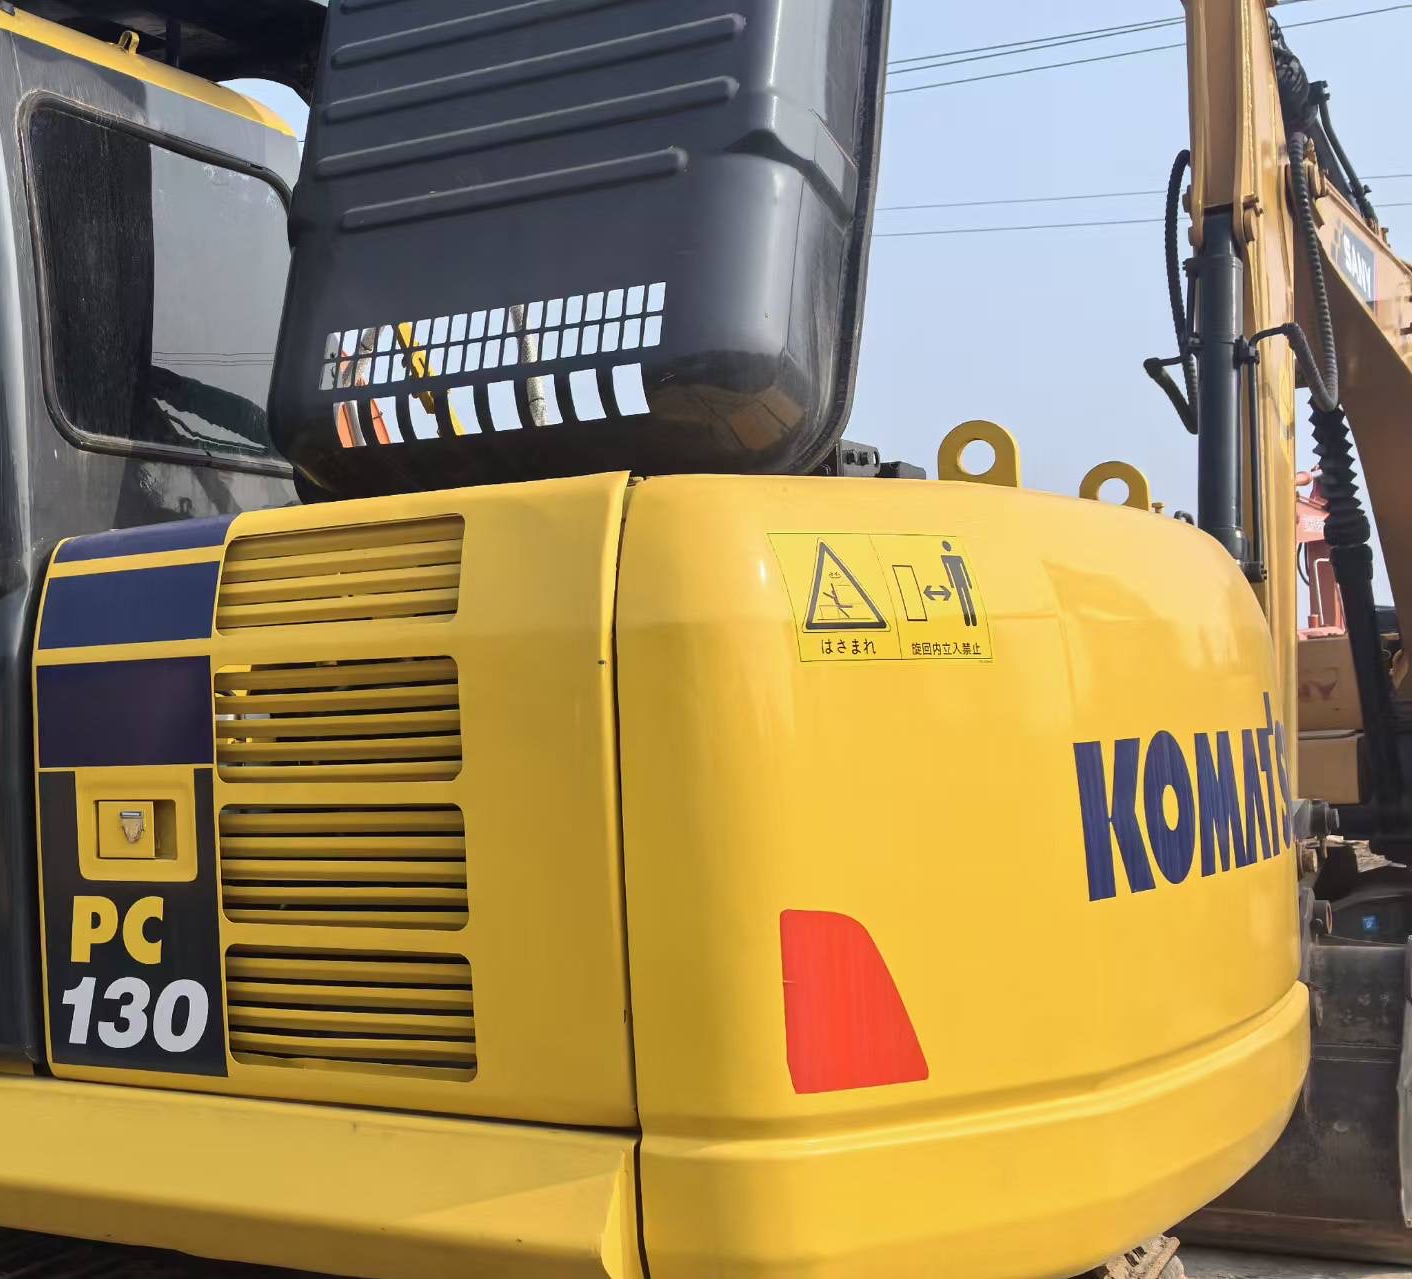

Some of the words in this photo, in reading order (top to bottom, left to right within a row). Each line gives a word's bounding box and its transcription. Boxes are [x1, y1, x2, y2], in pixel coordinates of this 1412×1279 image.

[821, 638, 877, 655] はさまれ
[911, 642, 982, 656] 旋回内立入禁止
[1073, 691, 1293, 902] KOMATS
[70, 895, 164, 965] PC
[62, 976, 209, 1053] 130
